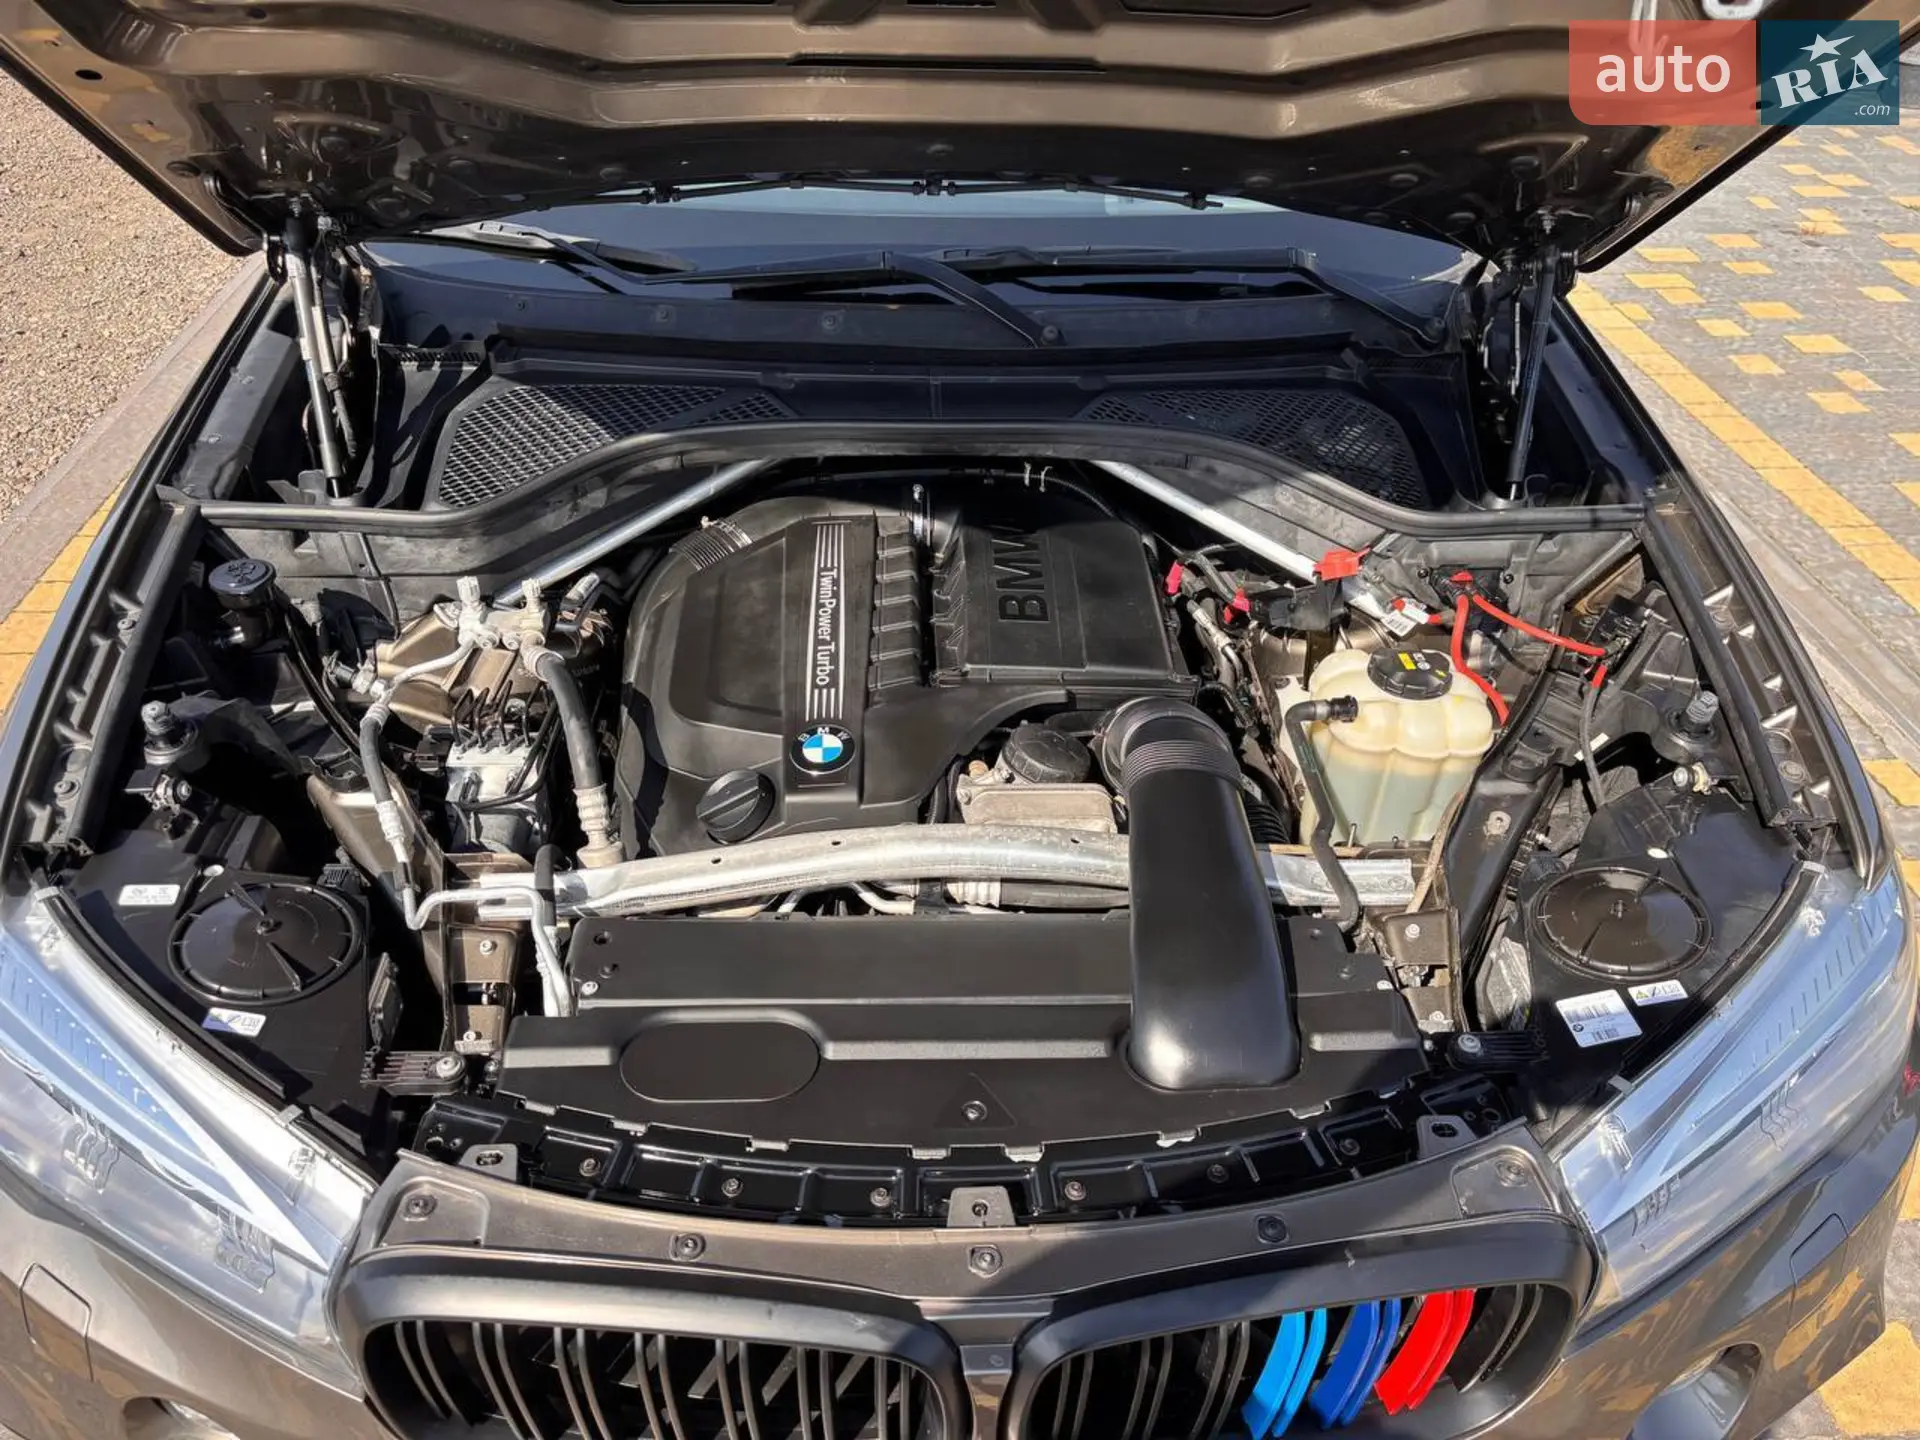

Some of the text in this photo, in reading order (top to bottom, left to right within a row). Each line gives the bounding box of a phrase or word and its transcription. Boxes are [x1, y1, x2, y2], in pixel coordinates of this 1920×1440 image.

[815, 568, 837, 685] TwinPower Turbo
[797, 726, 850, 742] BMW
